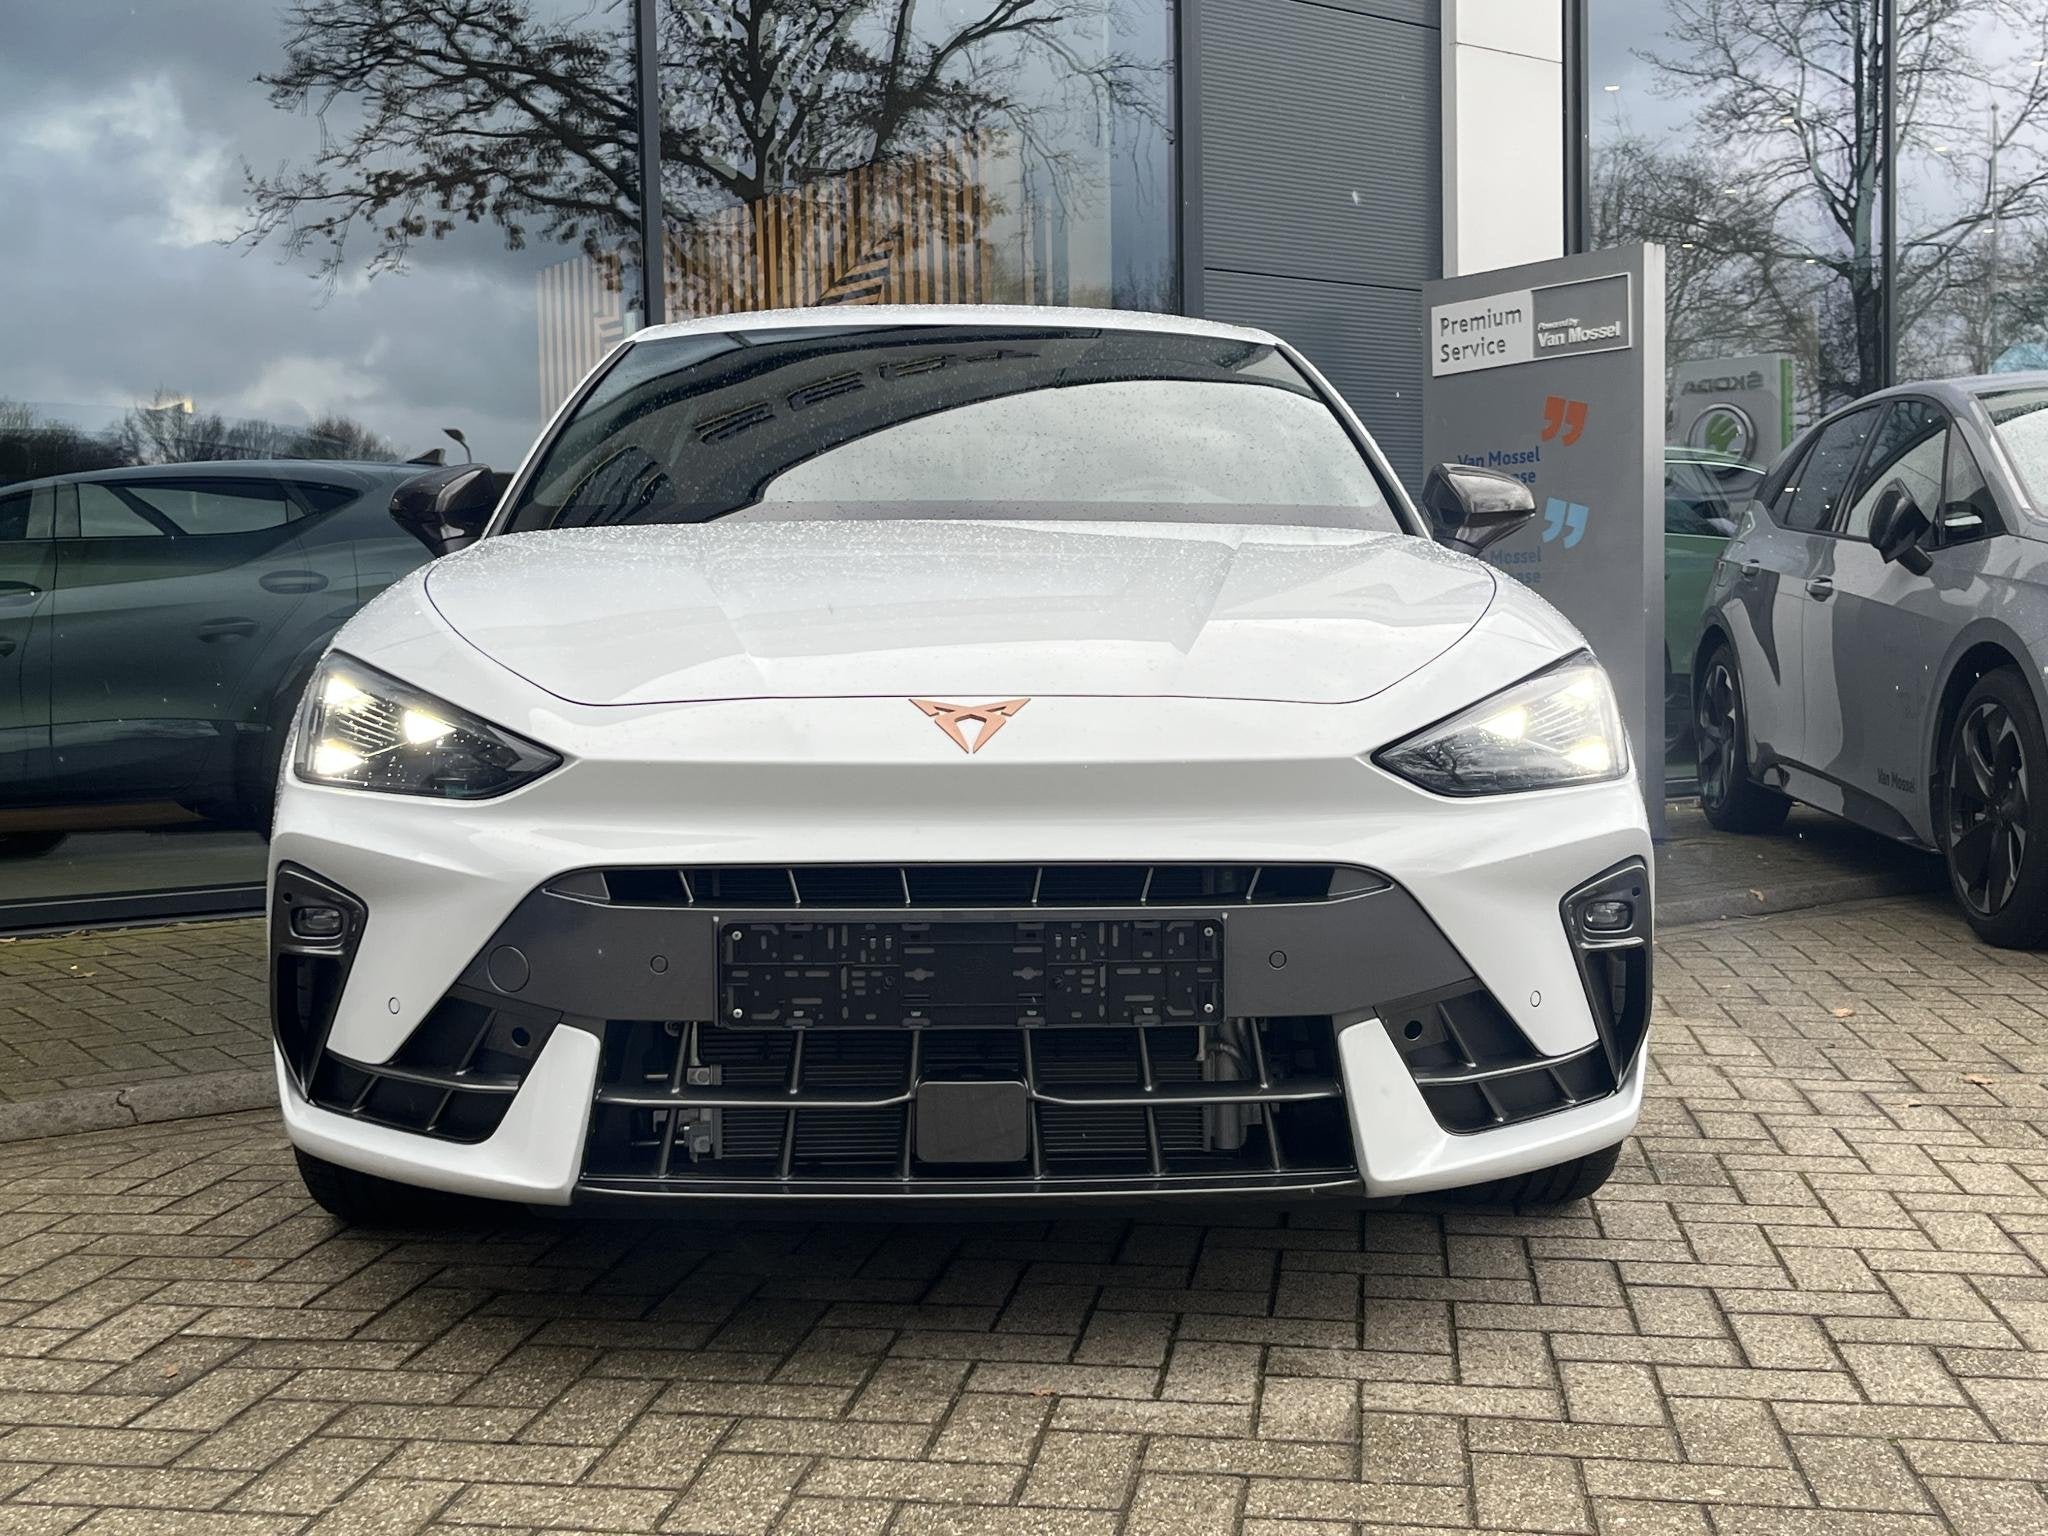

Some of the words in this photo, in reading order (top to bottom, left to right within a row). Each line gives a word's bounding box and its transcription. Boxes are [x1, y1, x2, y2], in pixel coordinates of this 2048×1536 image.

[1440, 308, 1522, 337] Premium
[1538, 332, 1565, 347] Van
[1568, 320, 1621, 343] Mossel
[1440, 336, 1506, 363] Service
[1457, 453, 1485, 468] Van
[1488, 445, 1541, 467] Mossel
[1490, 545, 1542, 565] Mossel
[1876, 767, 1890, 787] Van
